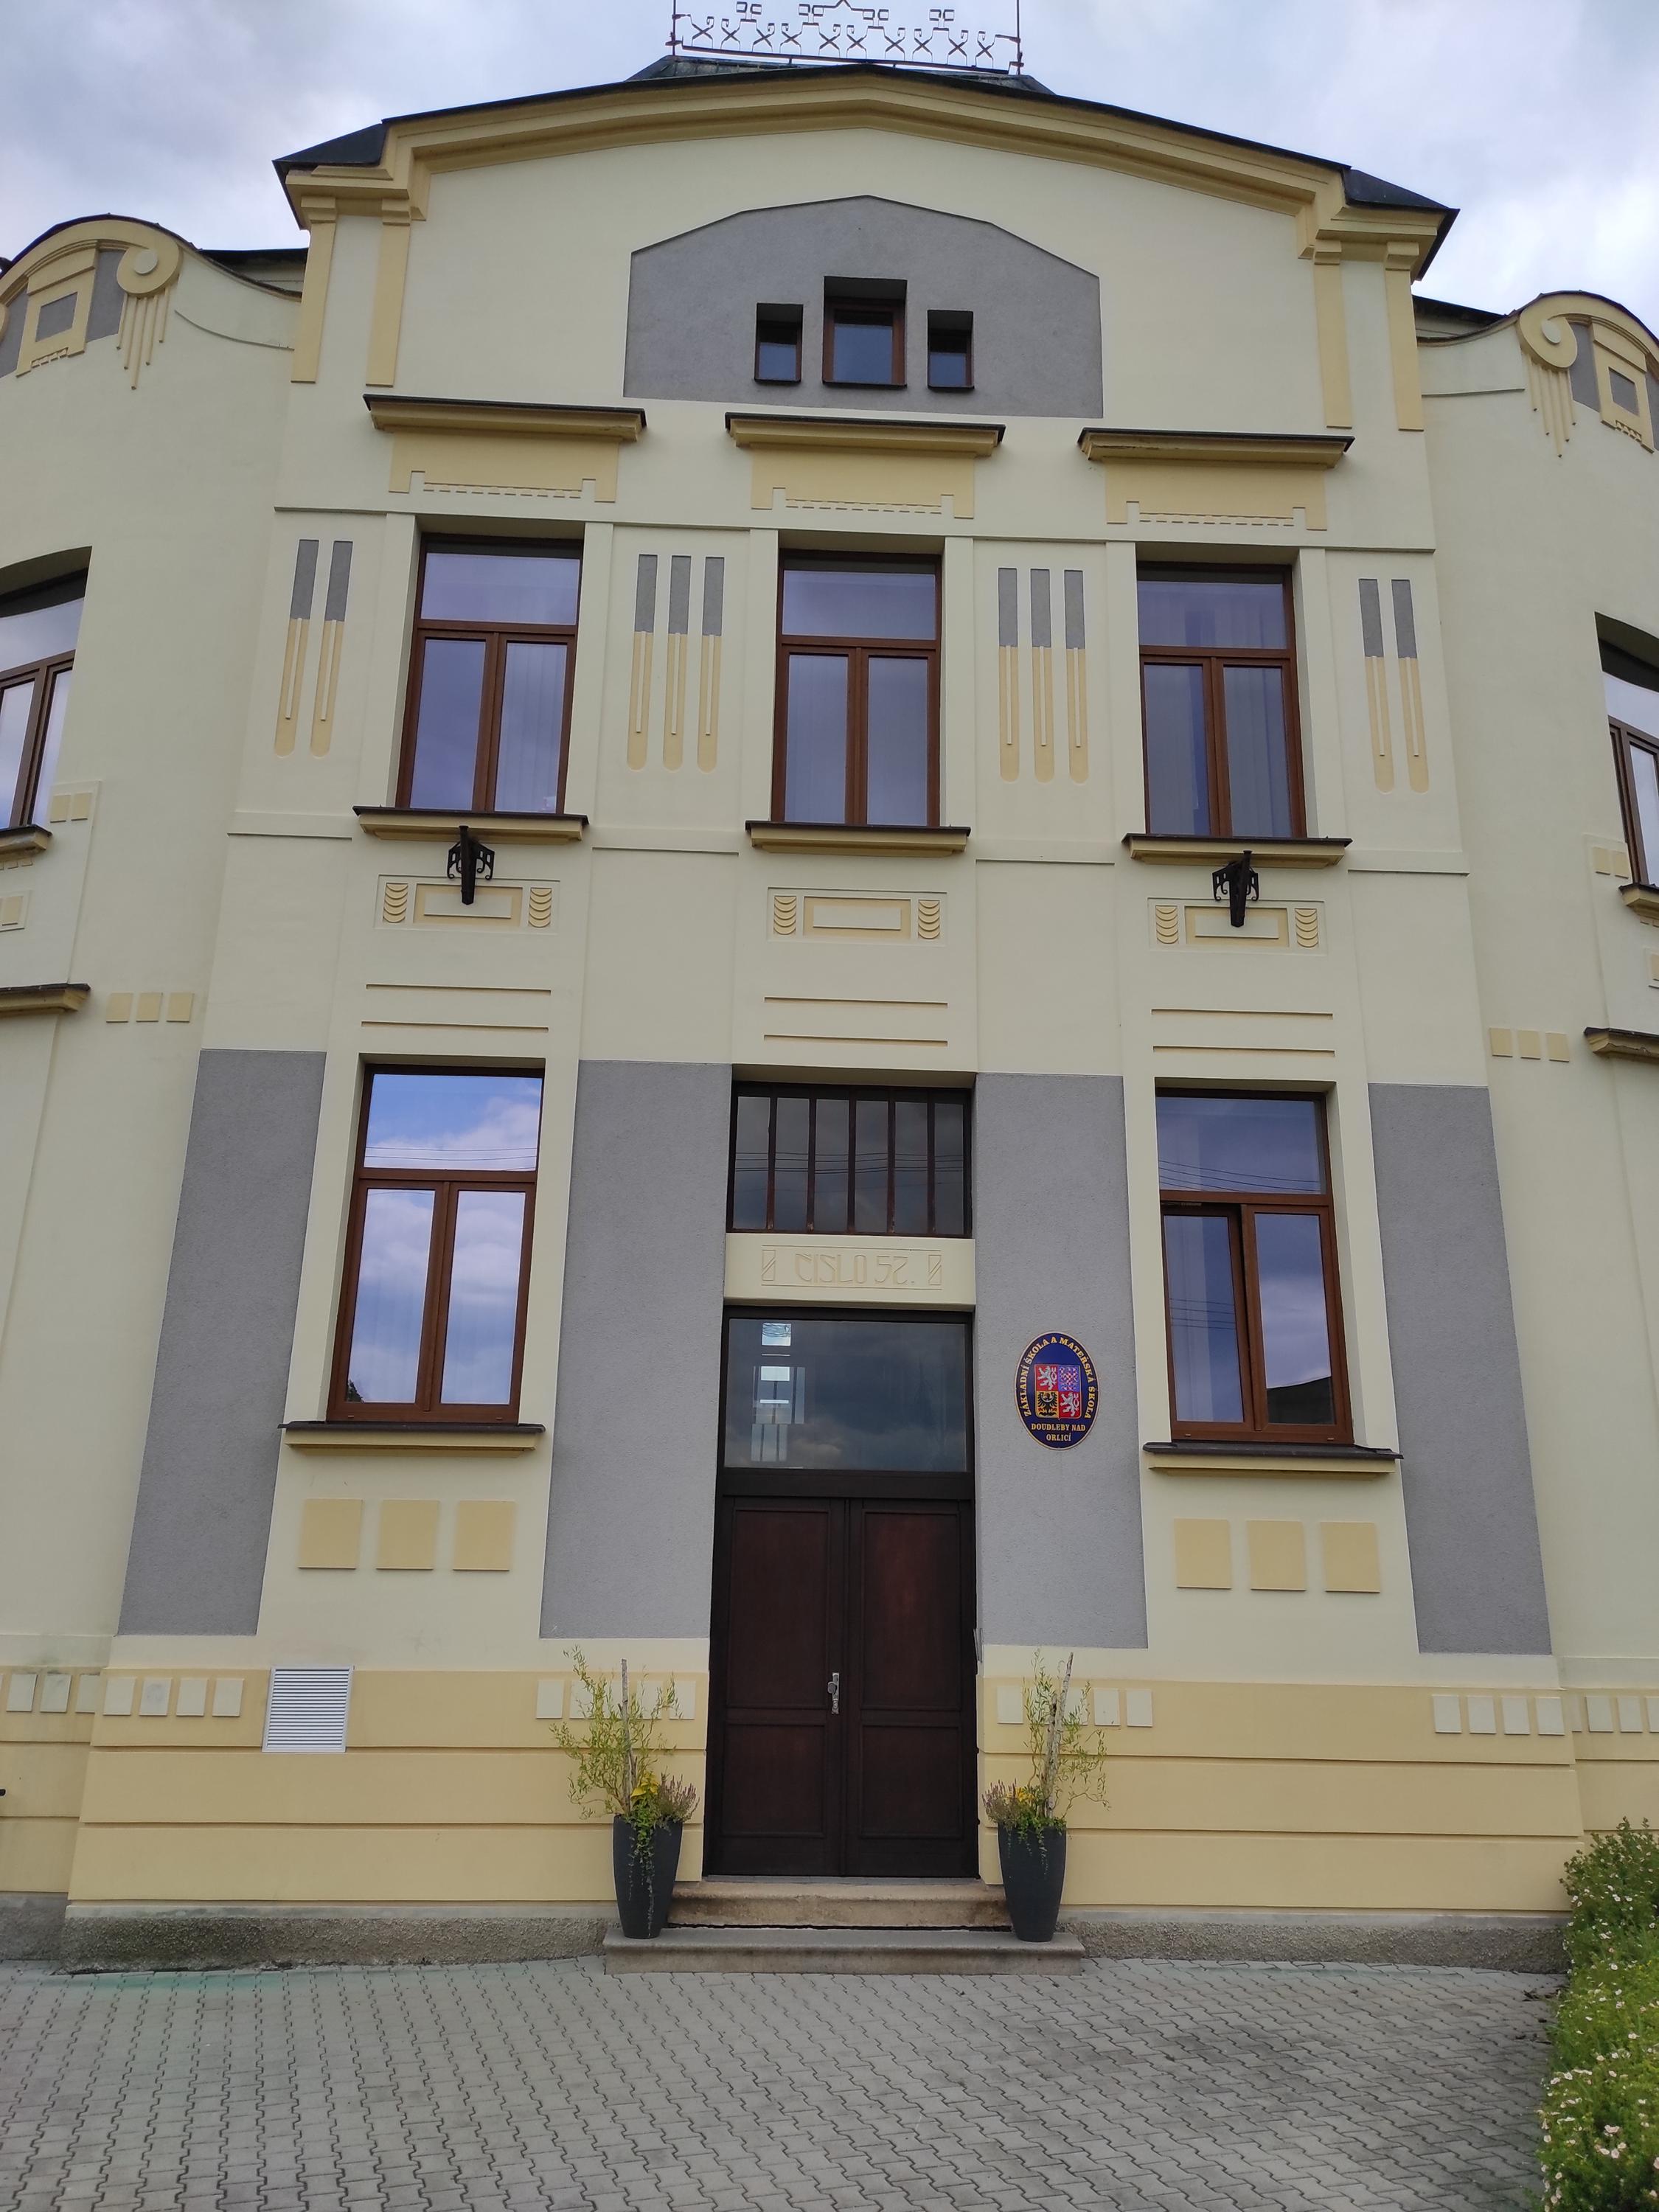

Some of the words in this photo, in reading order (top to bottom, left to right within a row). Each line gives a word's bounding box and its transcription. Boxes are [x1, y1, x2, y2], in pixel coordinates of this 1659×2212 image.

[1024, 1338, 1050, 1364] ŠKOLA
[1059, 1337, 1096, 1383] MATEŘSKÁ
[1020, 1365, 1032, 1416] ZÁKLADNÍ
[1085, 1386, 1097, 1419] ŠKOLA
[1031, 1423, 1070, 1431] DOUDLEBY
[1046, 1432, 1071, 1441] ORLICÍ
